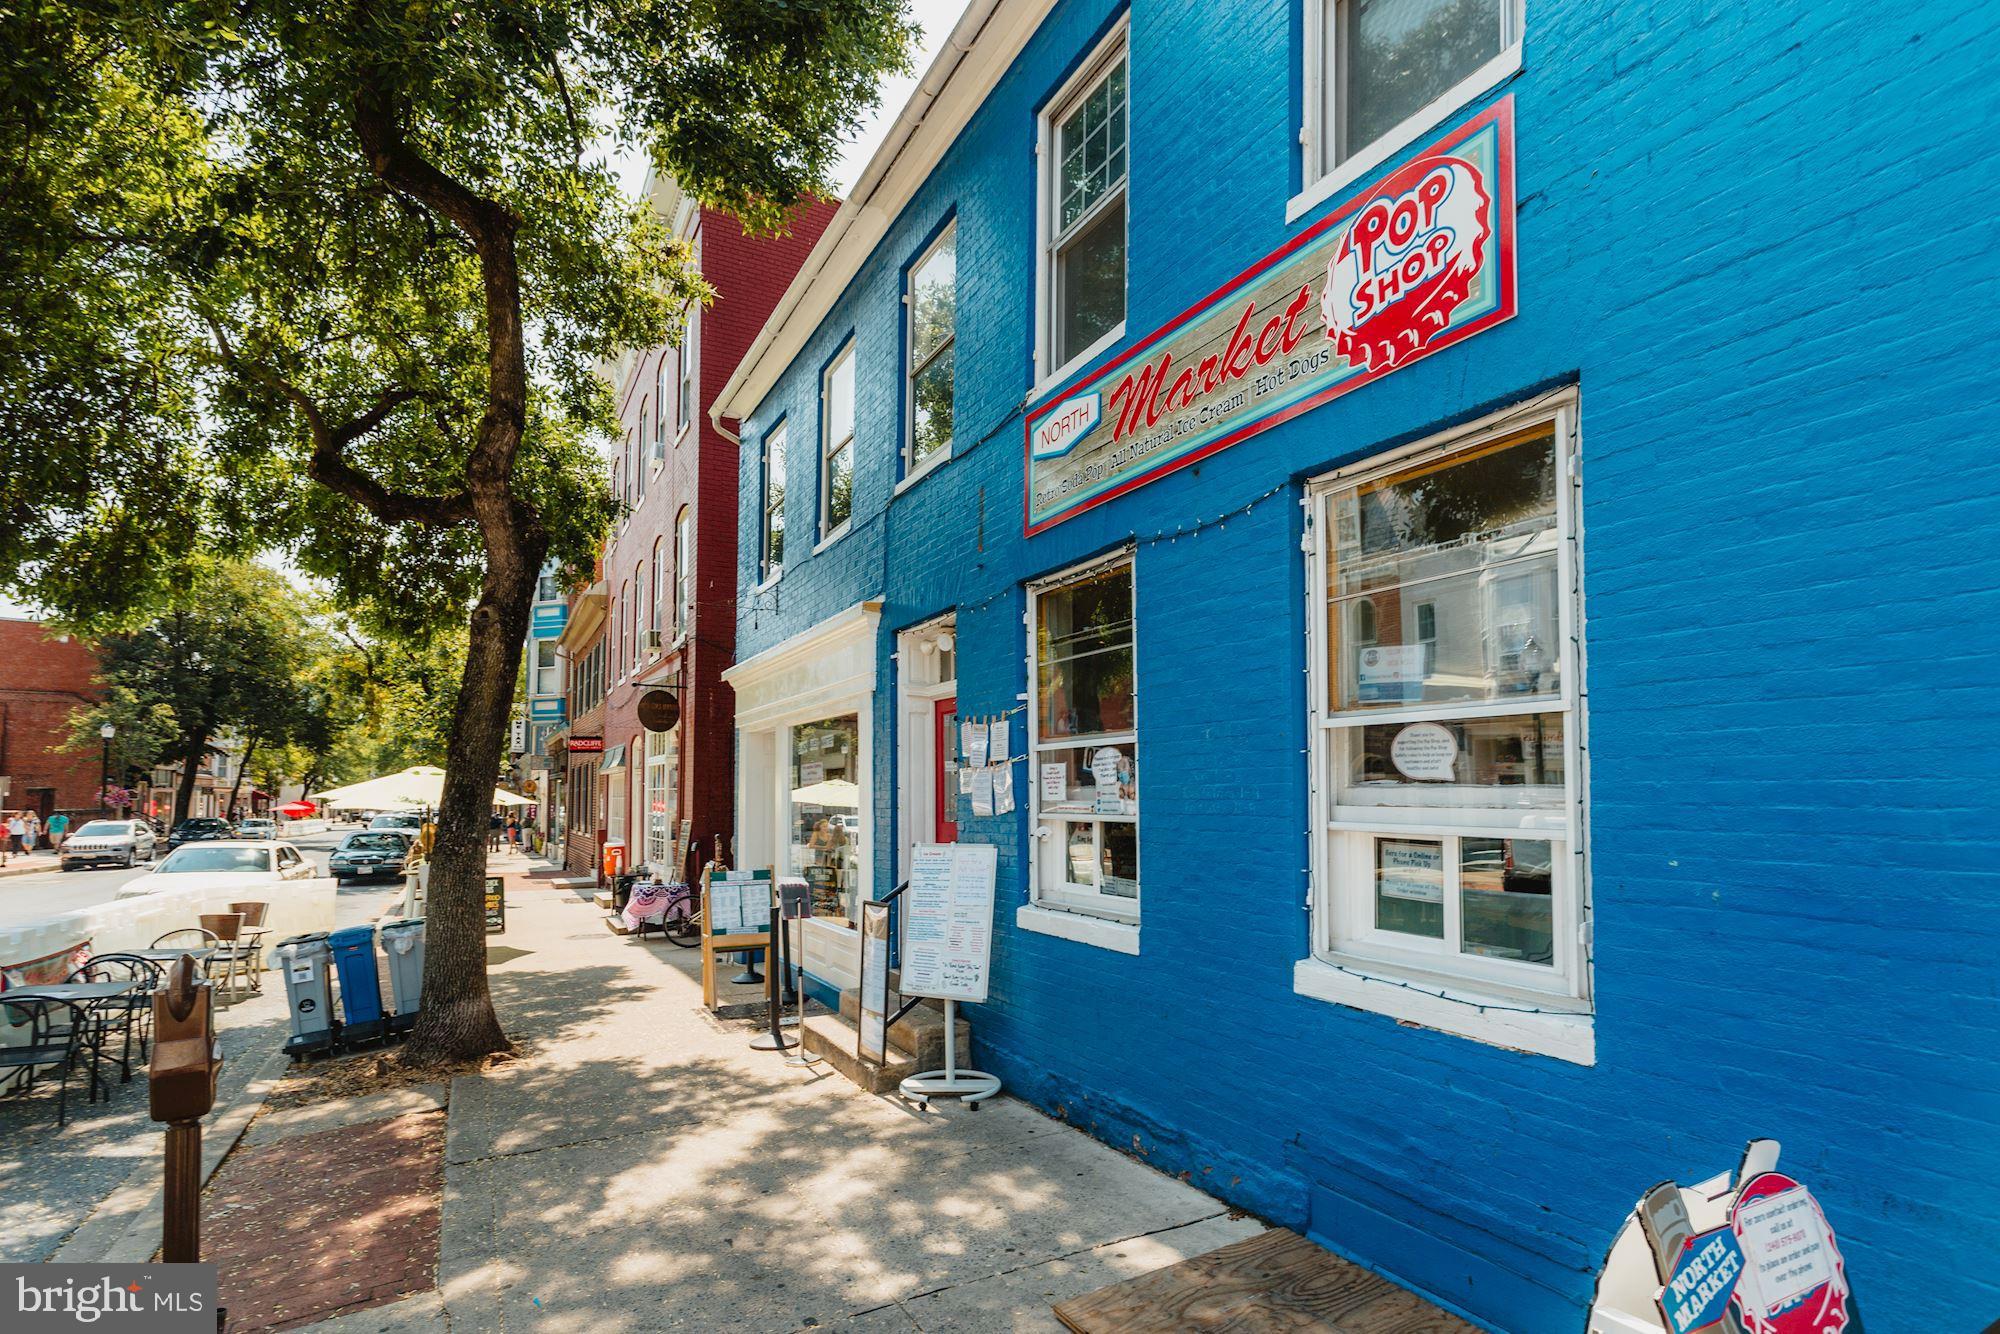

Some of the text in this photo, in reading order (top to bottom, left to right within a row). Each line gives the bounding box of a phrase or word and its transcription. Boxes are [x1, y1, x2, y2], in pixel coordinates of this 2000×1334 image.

[1353, 174, 1447, 274] POP
[1355, 234, 1449, 321] SHOP
[1108, 283, 1313, 443] Market
[1036, 348, 1329, 507] Retro Soda Pop All Natural Ice Cream Hot Dogs
[1041, 402, 1090, 448] NORTH
[1670, 1236, 1726, 1303] NORTH
[1674, 1250, 1739, 1332] MARKET
